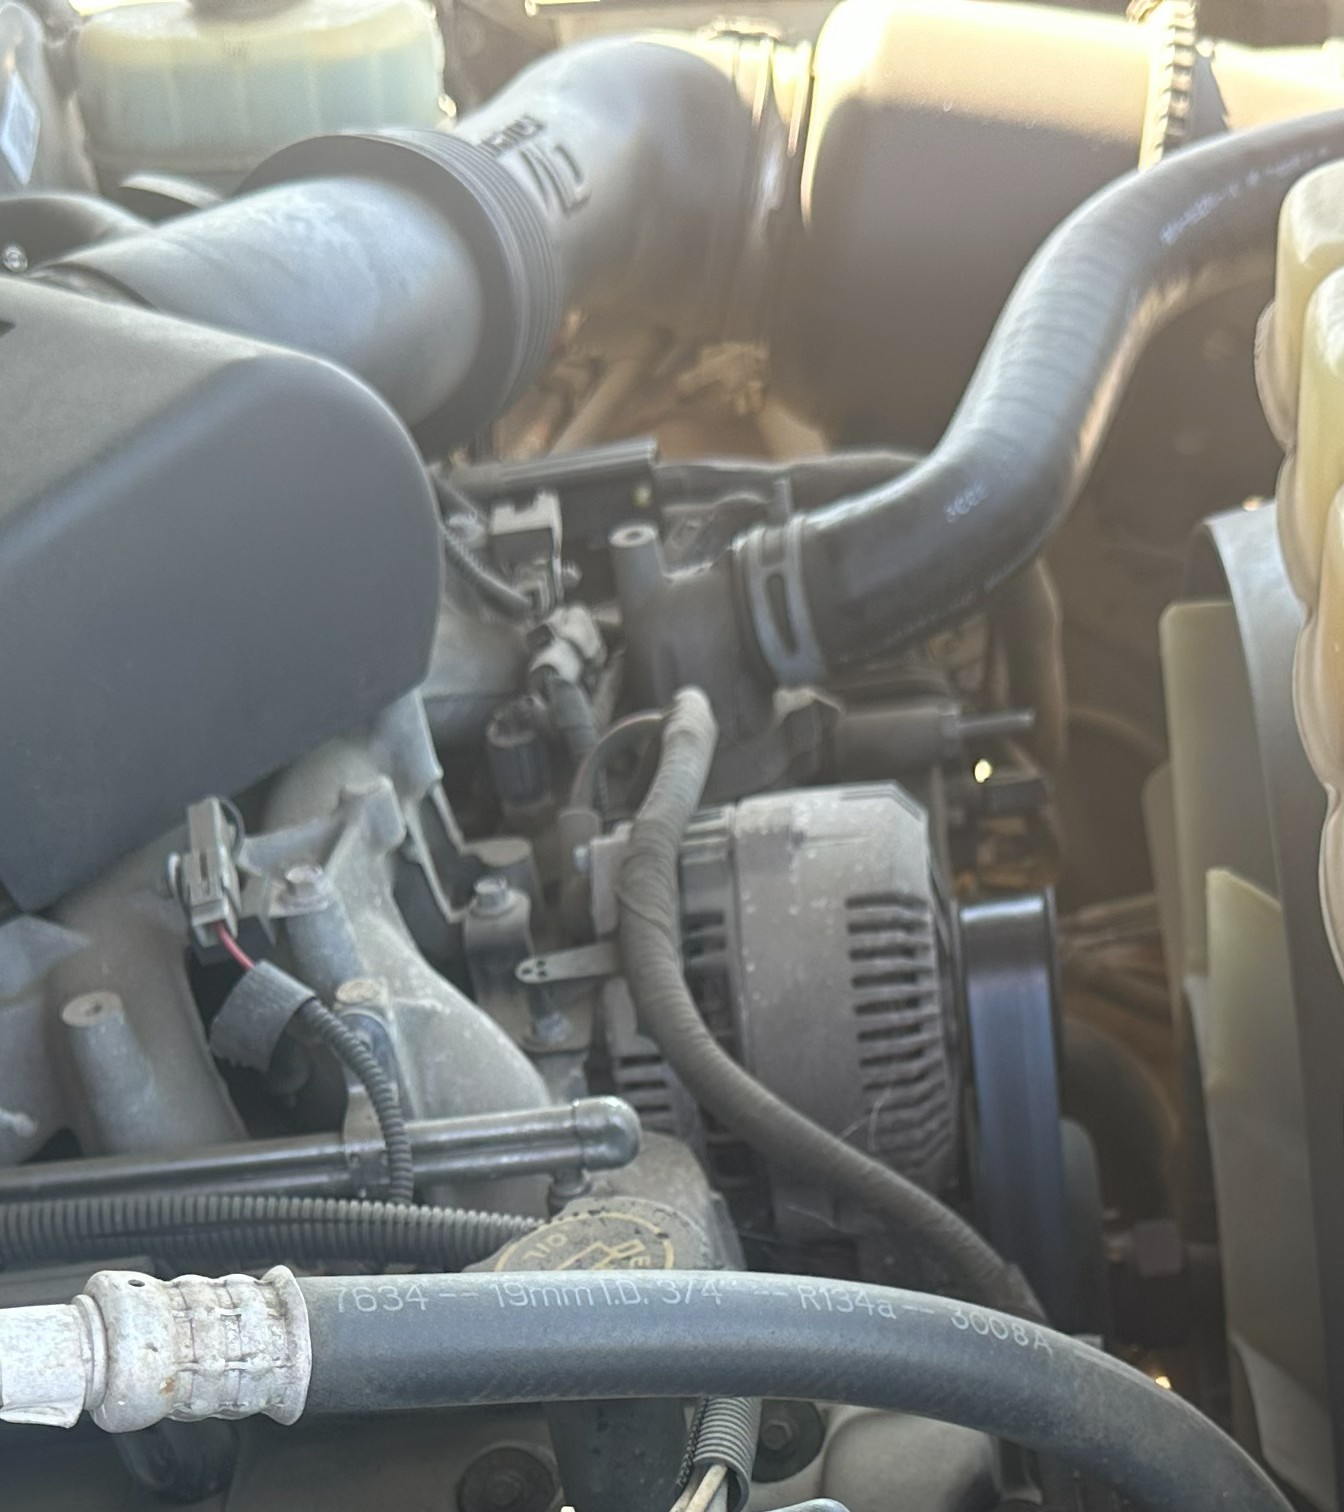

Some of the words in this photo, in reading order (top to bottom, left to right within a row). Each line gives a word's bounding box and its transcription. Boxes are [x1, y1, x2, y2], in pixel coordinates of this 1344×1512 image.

[329, 1284, 429, 1313] 7634
[490, 1281, 594, 1308] 19mm
[797, 1284, 897, 1319] R134a
